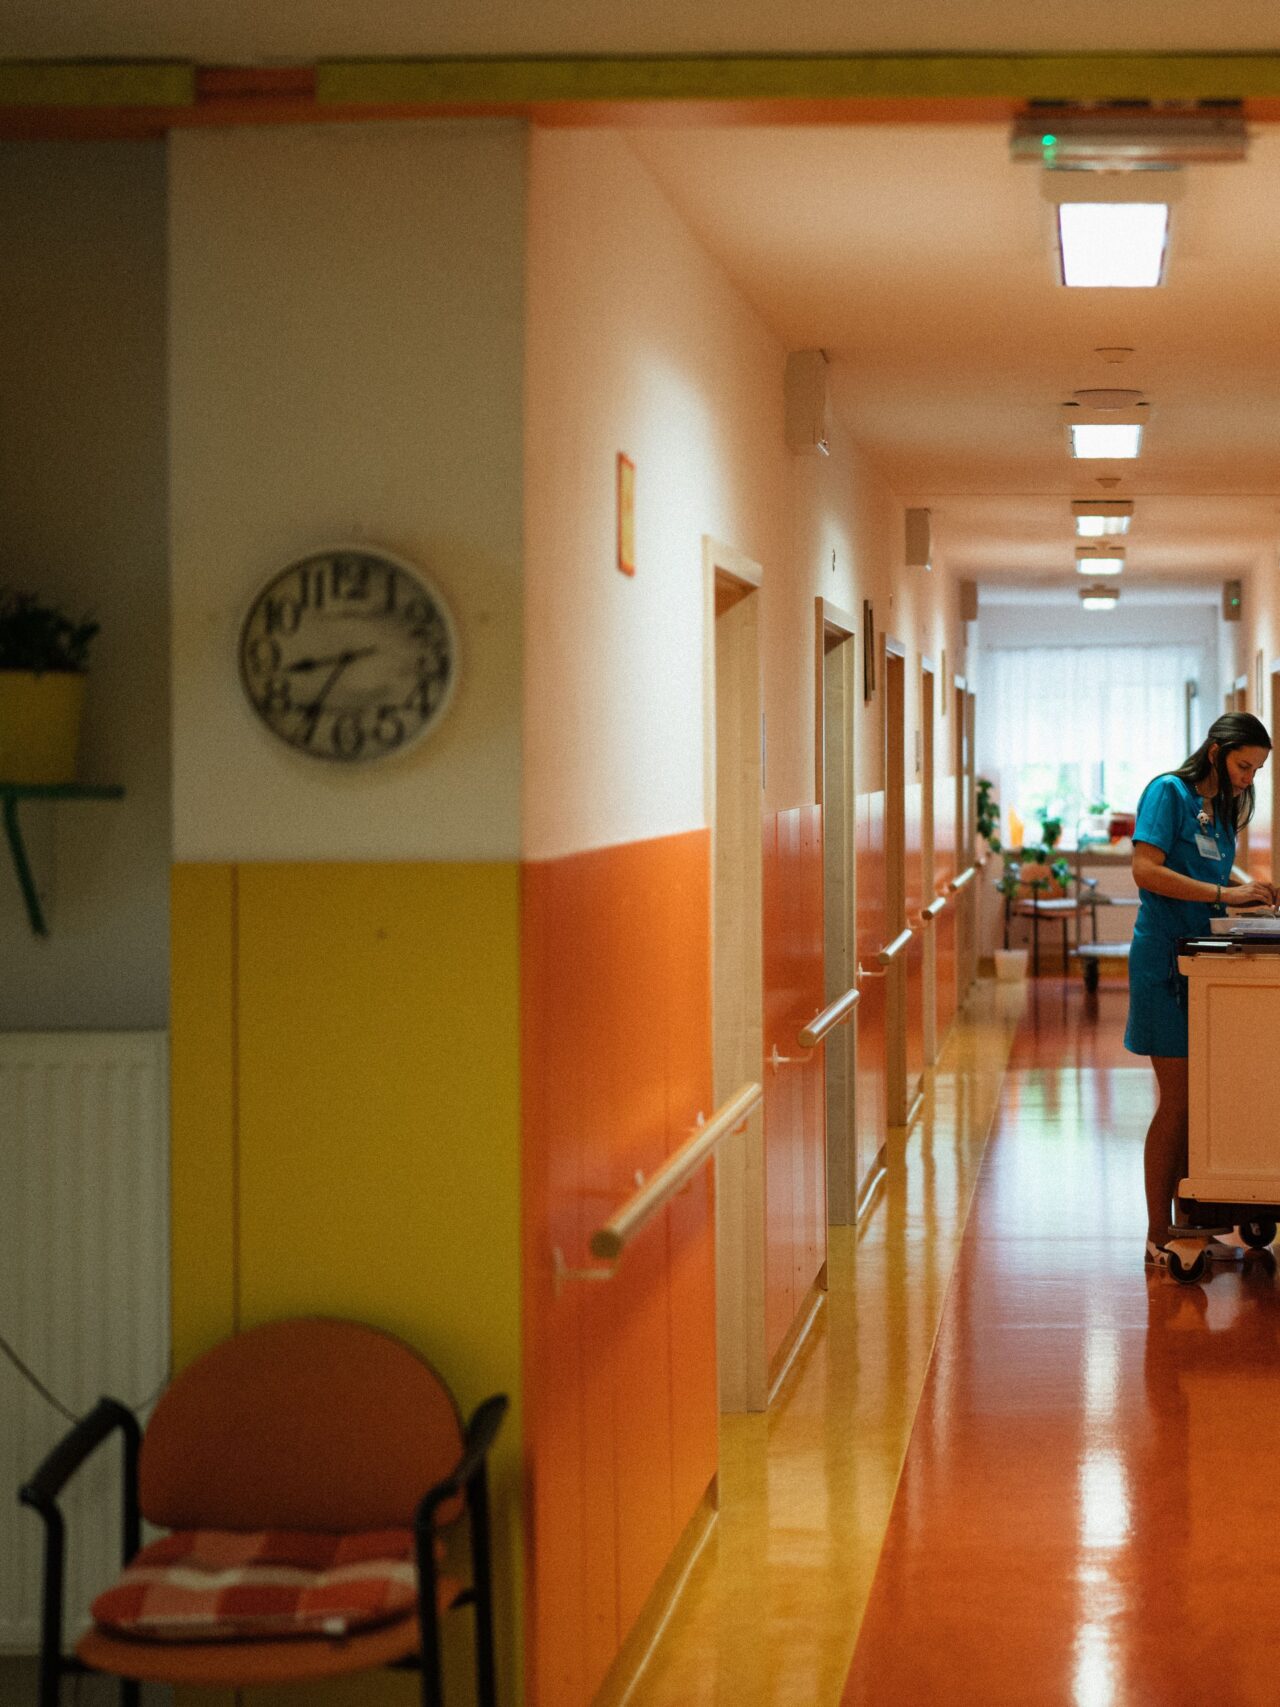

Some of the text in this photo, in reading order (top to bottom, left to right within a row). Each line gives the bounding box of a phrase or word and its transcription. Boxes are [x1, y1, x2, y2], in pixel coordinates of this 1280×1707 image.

[300, 568, 325, 609] 11
[331, 559, 371, 600] 12
[384, 567, 398, 613] 1
[264, 598, 302, 637] 10
[331, 710, 366, 759] 6
[373, 703, 406, 748] 5
